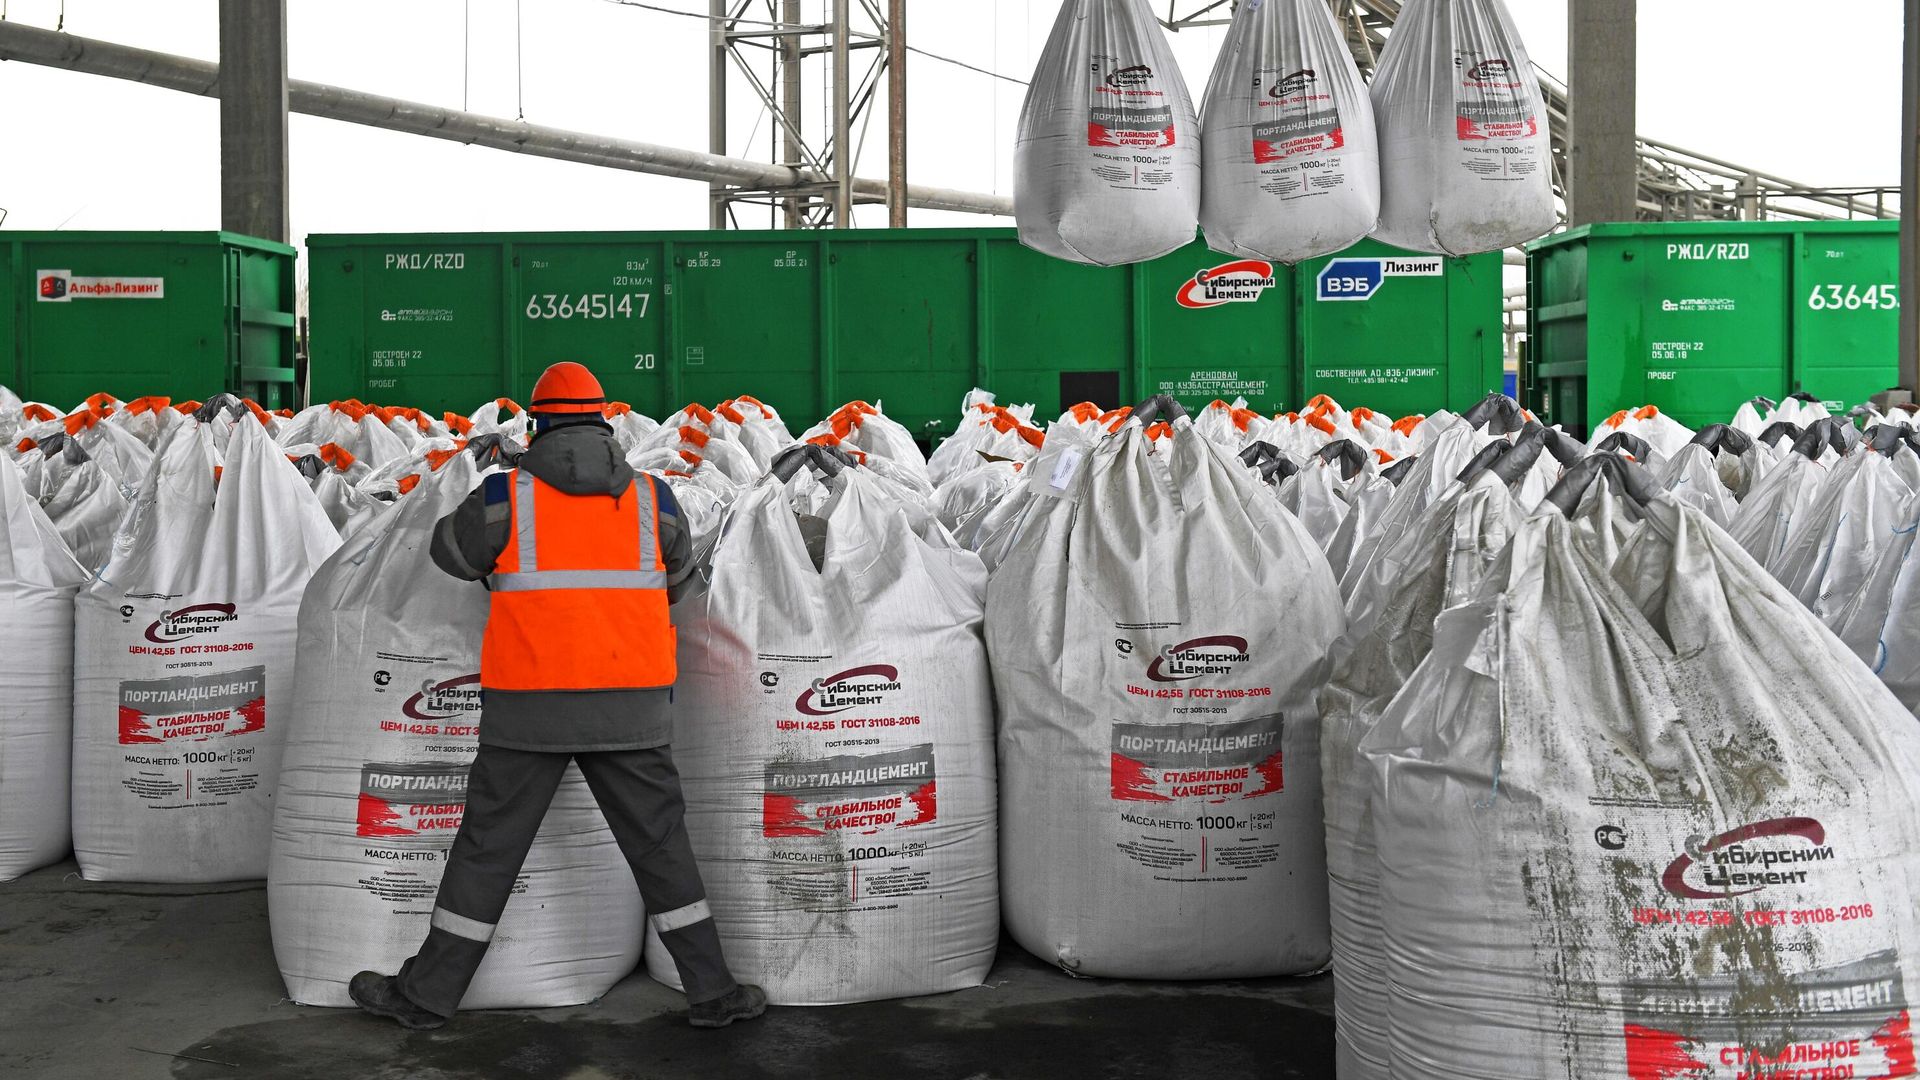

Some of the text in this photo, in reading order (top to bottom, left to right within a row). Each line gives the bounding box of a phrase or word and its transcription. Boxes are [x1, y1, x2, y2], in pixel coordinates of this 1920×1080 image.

[1093, 113, 1170, 124] ПОРТЛАНДЦЕМЕНТ
[1257, 117, 1337, 136] ПОРТЛАНДЦЕМЕНТ
[1280, 135, 1324, 149] СТАБИЛЬНОЕ
[1286, 143, 1322, 155] КАЧЕСТВО!
[1132, 155, 1152, 163] 1000
[1300, 161, 1320, 169] 1000
[1667, 244, 1749, 260] РЖД/RZD
[386, 253, 464, 269] РЖД/RZD
[1384, 261, 1439, 273] Лизинг
[613, 277, 628, 285] 120
[1197, 269, 1274, 289] Сибирский
[1327, 277, 1370, 292] ВЭБ
[70, 282, 159, 294] Альфа-Лизинг
[1205, 286, 1258, 299] Цемент
[1808, 285, 1900, 310] 63645
[526, 294, 649, 318] 63645147
[1652, 342, 1703, 350] ПОСТРОЕН 22
[373, 350, 422, 359] ПОСТРОЕН 22
[635, 354, 655, 369] 20
[1652, 351, 1687, 359] 05.06.18
[1316, 369, 1367, 377] СОБСТВЕННИК
[1371, 369, 1381, 377] АО
[1648, 372, 1676, 380] ПРОБЕГ
[369, 380, 397, 388] ПРОБЕГ
[160, 610, 238, 626] Сибирский
[165, 625, 219, 635] Цемент
[129, 645, 147, 654] ЦЕМ
[180, 646, 202, 654] ГОСТ
[204, 642, 253, 653] 31108-2016
[1161, 644, 1249, 664] Сибирский
[1170, 661, 1231, 674] Цемент
[125, 681, 258, 702] ПОРТЛАНДЦЕМЕНТ
[812, 678, 901, 695] Сибирский
[1127, 684, 1148, 697] ЦЕМ
[1189, 689, 1214, 698] ГОСТ
[1217, 687, 1271, 698] 31108-2016
[427, 698, 483, 711] Цемен
[821, 695, 882, 707] Цемент
[157, 710, 231, 727] СТАБИЛЬНОЕ
[776, 720, 799, 731] ЦЕМ
[841, 719, 866, 729] ГОСТ
[868, 716, 920, 728] 31108-2016
[163, 723, 224, 739] КАЧЕСТВО!
[380, 721, 402, 731] ЦЕМ
[444, 727, 470, 735] ГОСТ
[843, 738, 880, 746] 30515-2013
[1120, 731, 1277, 753] ПОРТЛАНДЦЕМЕНТ
[125, 755, 151, 764] МАССА
[153, 757, 180, 765] НЕТТО:
[182, 752, 216, 763] 1000
[773, 762, 928, 787] ПОРТЛАНДЦЕМЕНТ
[1164, 768, 1248, 783] СТАБИЛЬНОЕ
[368, 774, 468, 791] ПОРТЛАНД
[1172, 782, 1242, 797] КАЧЕСТВО!
[409, 804, 464, 815] СТАБИЛ
[816, 797, 902, 817] СТАБИЛЬНОЕ
[417, 818, 462, 829] КАЧЕС
[825, 812, 896, 830] КАЧЕСТВО!
[1121, 813, 1248, 830] МАССА НЕТТО: 1000 кг
[365, 849, 437, 861] МАССА НЕТТО:
[772, 851, 808, 861] МАССА
[810, 854, 844, 863] НЕТТО:
[848, 847, 887, 860] 1000
[1684, 834, 1834, 869] Сибирский
[1703, 865, 1807, 886] Цемент
[1744, 909, 1787, 926] ГОСТ
[1791, 904, 1873, 924] 31108-2016
